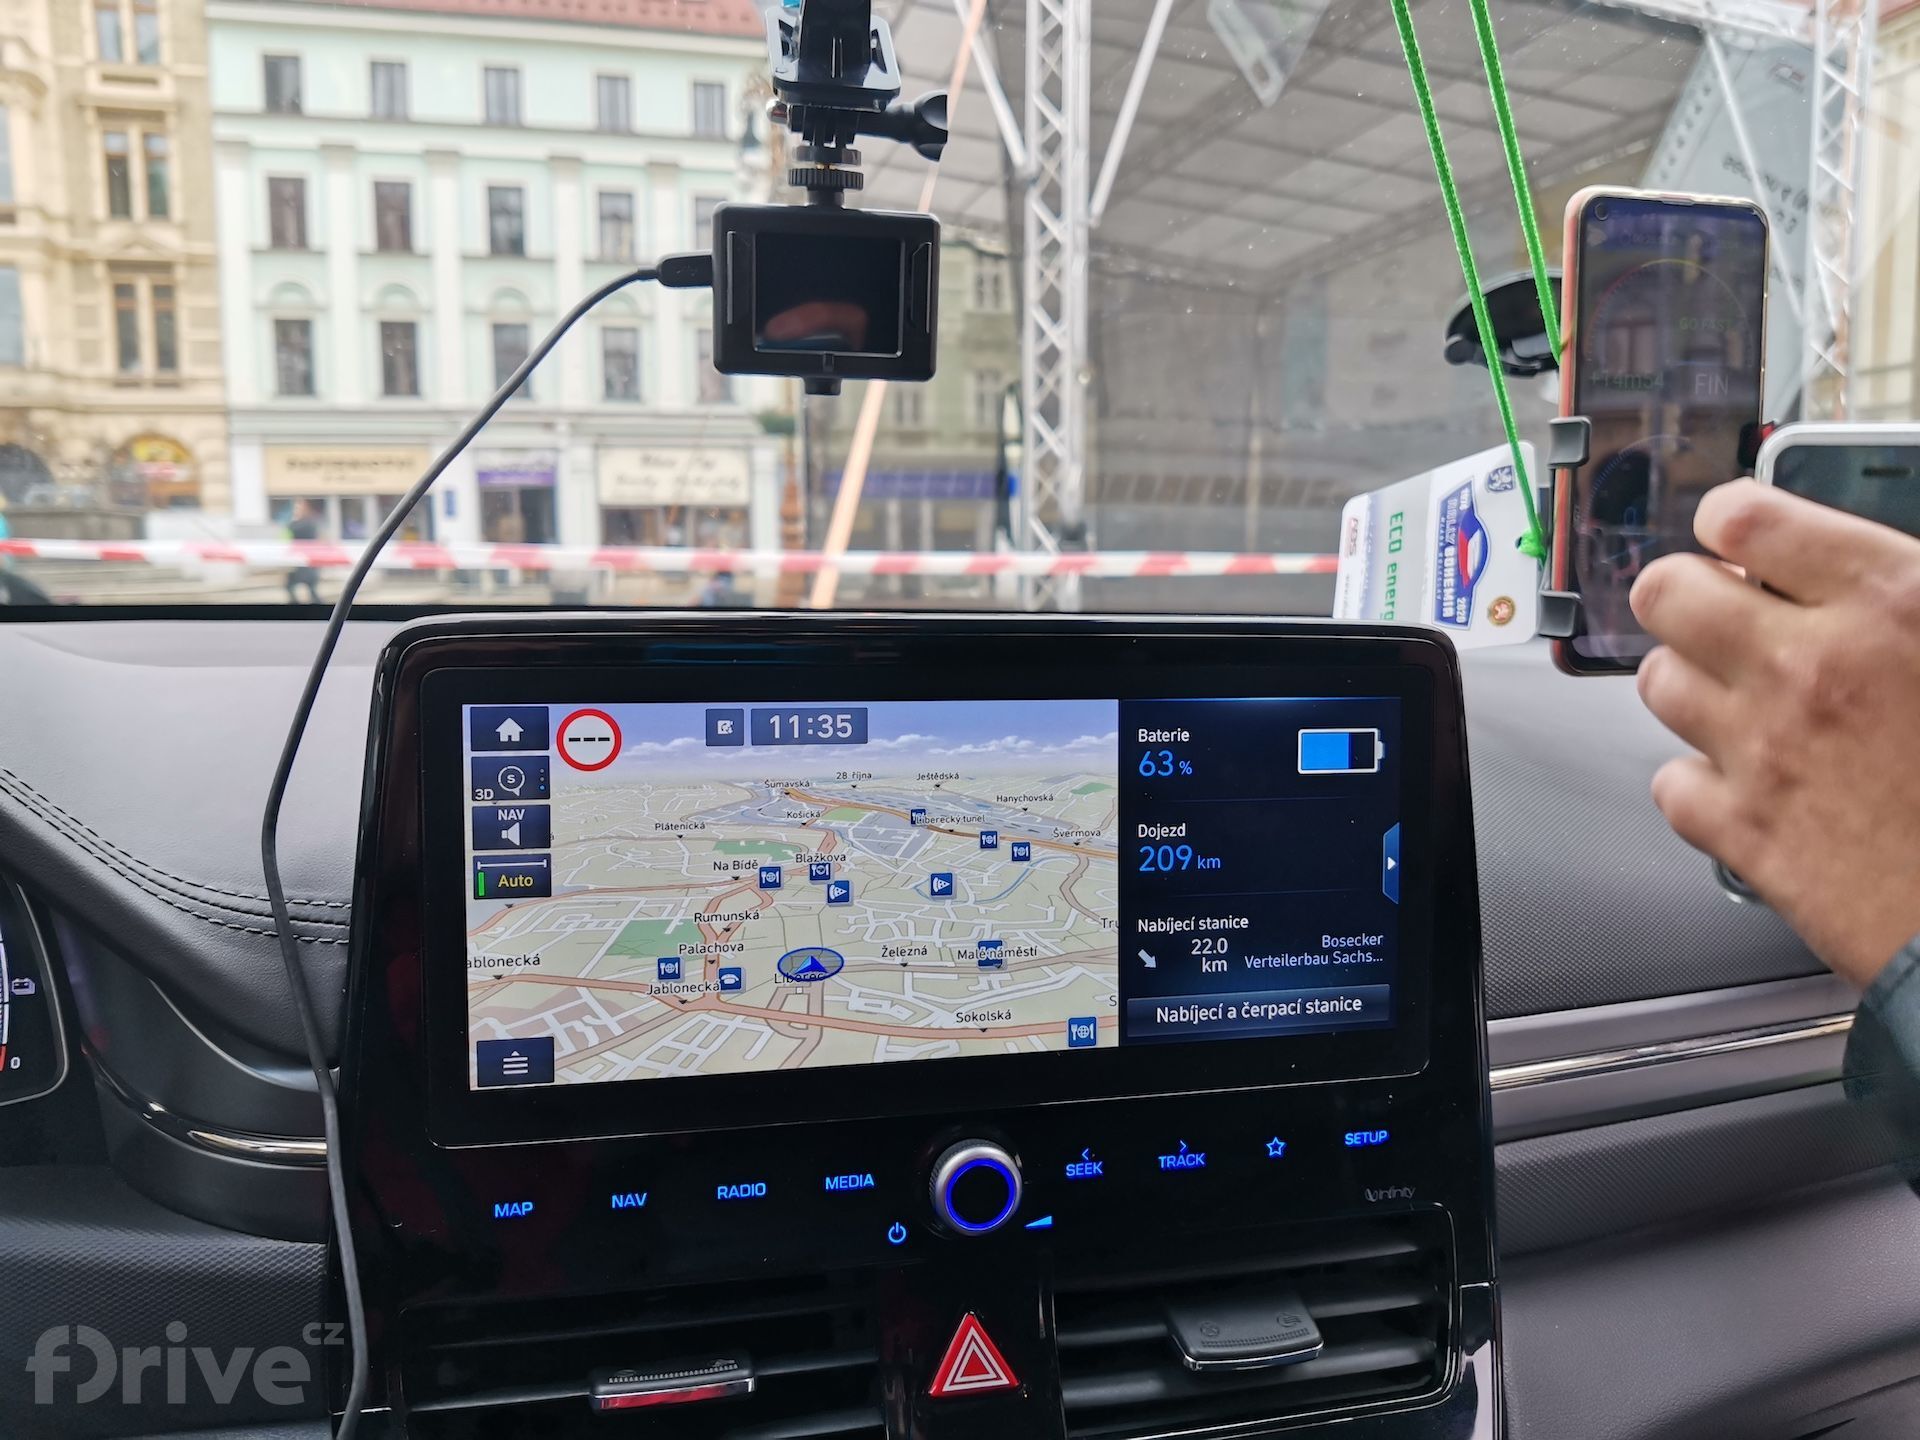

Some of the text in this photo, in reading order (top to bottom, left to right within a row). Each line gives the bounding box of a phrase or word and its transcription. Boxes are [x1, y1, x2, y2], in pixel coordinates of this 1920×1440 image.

[1695, 373, 1729, 395] FIN
[1388, 511, 1404, 555] ECO
[1443, 546, 1455, 618] BOHEMIA
[1456, 597, 1467, 624] 2020
[769, 713, 853, 739] 11:35
[1137, 728, 1190, 742] Baterie
[1138, 750, 1193, 777] 63 %
[764, 778, 810, 789] Šumavská
[835, 771, 873, 782] 28 října
[916, 772, 960, 782] Ještědská
[474, 788, 495, 801] 3D
[996, 794, 1054, 804] Hanychovská
[497, 808, 526, 821] NAV
[786, 810, 822, 819] Košická
[963, 814, 985, 823] tunel
[655, 820, 706, 832] Plátenická
[1053, 828, 1101, 839] Švermova
[1137, 823, 1186, 840] Dojezd
[713, 859, 759, 871] Na Bídě
[795, 853, 847, 864] Blažkova
[1138, 845, 1221, 872] 209 km
[497, 873, 534, 888] Auto
[694, 910, 760, 923] Rumunská
[1137, 915, 1249, 935] Nabíjecí stanice
[1190, 937, 1228, 955] 22.0
[1321, 933, 1384, 948] Bosecker
[679, 942, 744, 955] Palachova
[881, 944, 928, 958] Železná
[957, 945, 1038, 960] Malé náměstí
[1201, 957, 1228, 973] km
[1244, 952, 1329, 969] Verteilerbau
[647, 981, 721, 996] Jablonecká
[956, 1009, 1012, 1024] Sokolská
[1156, 995, 1363, 1026] Nabíjecí a čerpací stanice
[1344, 1130, 1389, 1146] SETUP
[1158, 1152, 1206, 1170] TRACK
[1065, 1161, 1103, 1177] SEEK
[824, 1173, 875, 1191] MEDIA
[716, 1182, 767, 1200] RADIO
[611, 1193, 648, 1209] NAV
[494, 1201, 534, 1219] MAP
